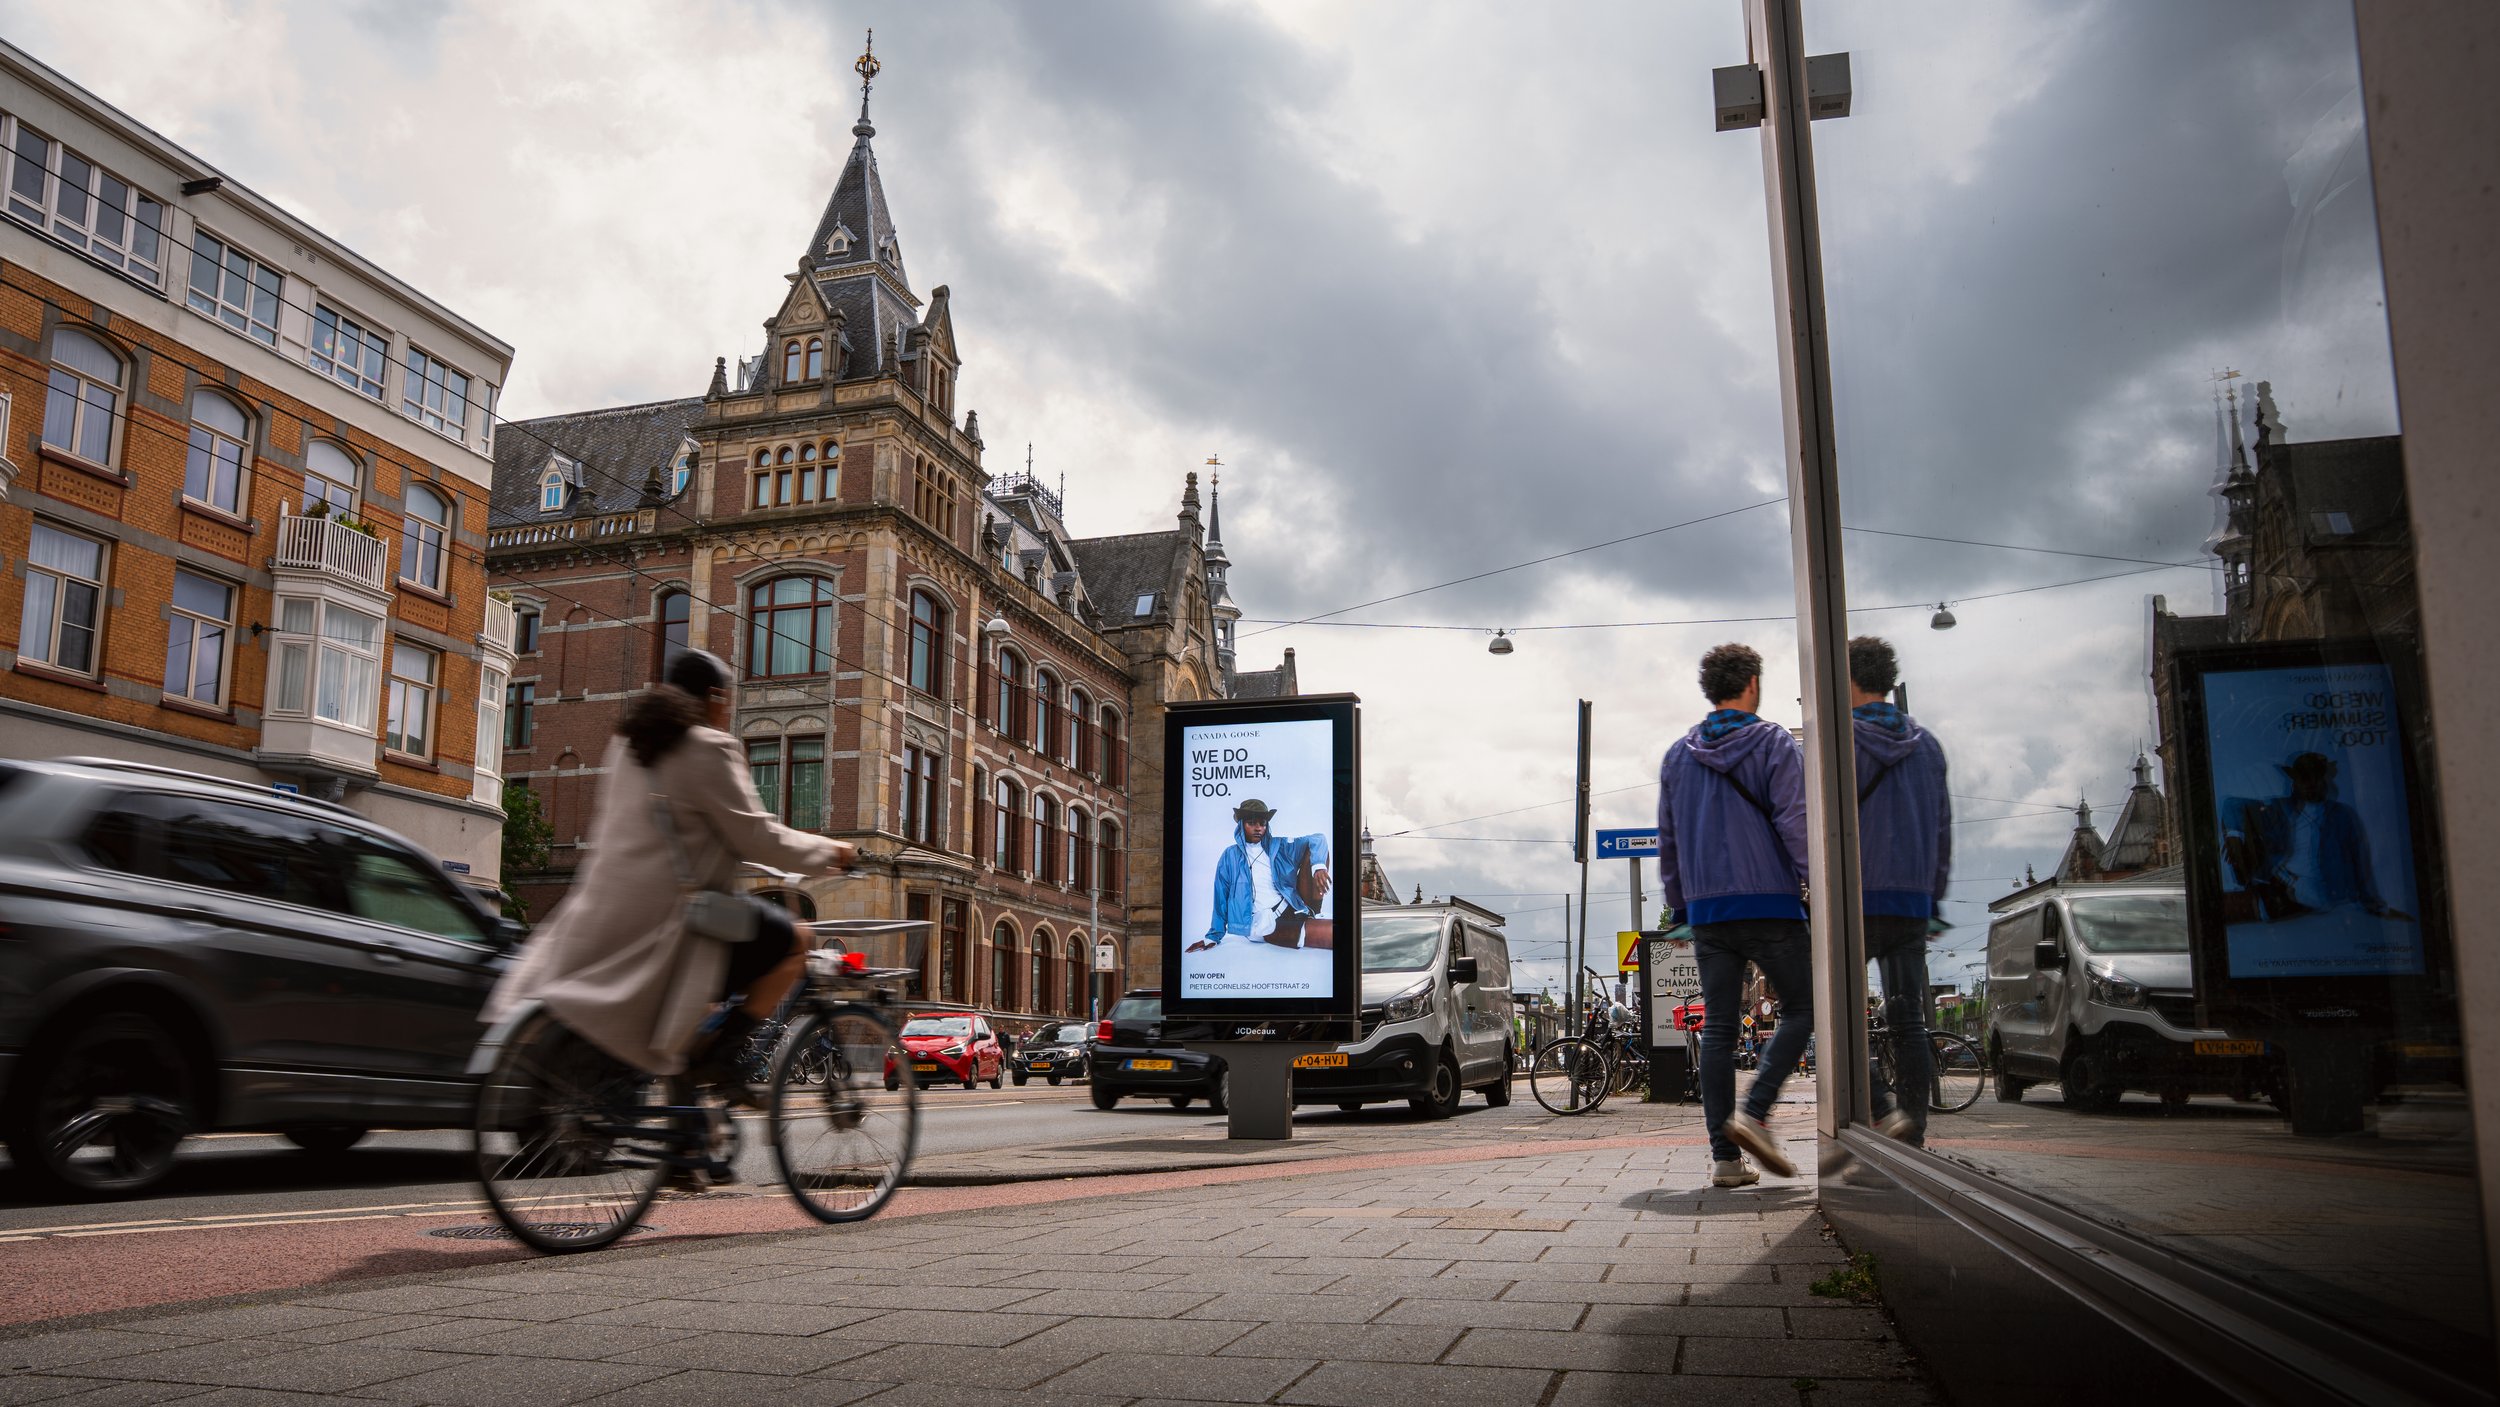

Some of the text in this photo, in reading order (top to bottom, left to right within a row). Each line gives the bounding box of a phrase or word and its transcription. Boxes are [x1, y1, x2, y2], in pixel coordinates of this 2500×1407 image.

[1191, 730, 1261, 741] CANADA GOOSE
[1192, 748, 1248, 764] WE DO
[1191, 764, 1271, 781] SUMMER,
[1191, 782, 1232, 797] TOO.
[1669, 964, 1698, 977] FÊTE
[1675, 988, 1700, 996] & VINS
[1235, 1027, 1276, 1035] JCDecaux
[1297, 1055, 1344, 1066] V-04-HVJ
